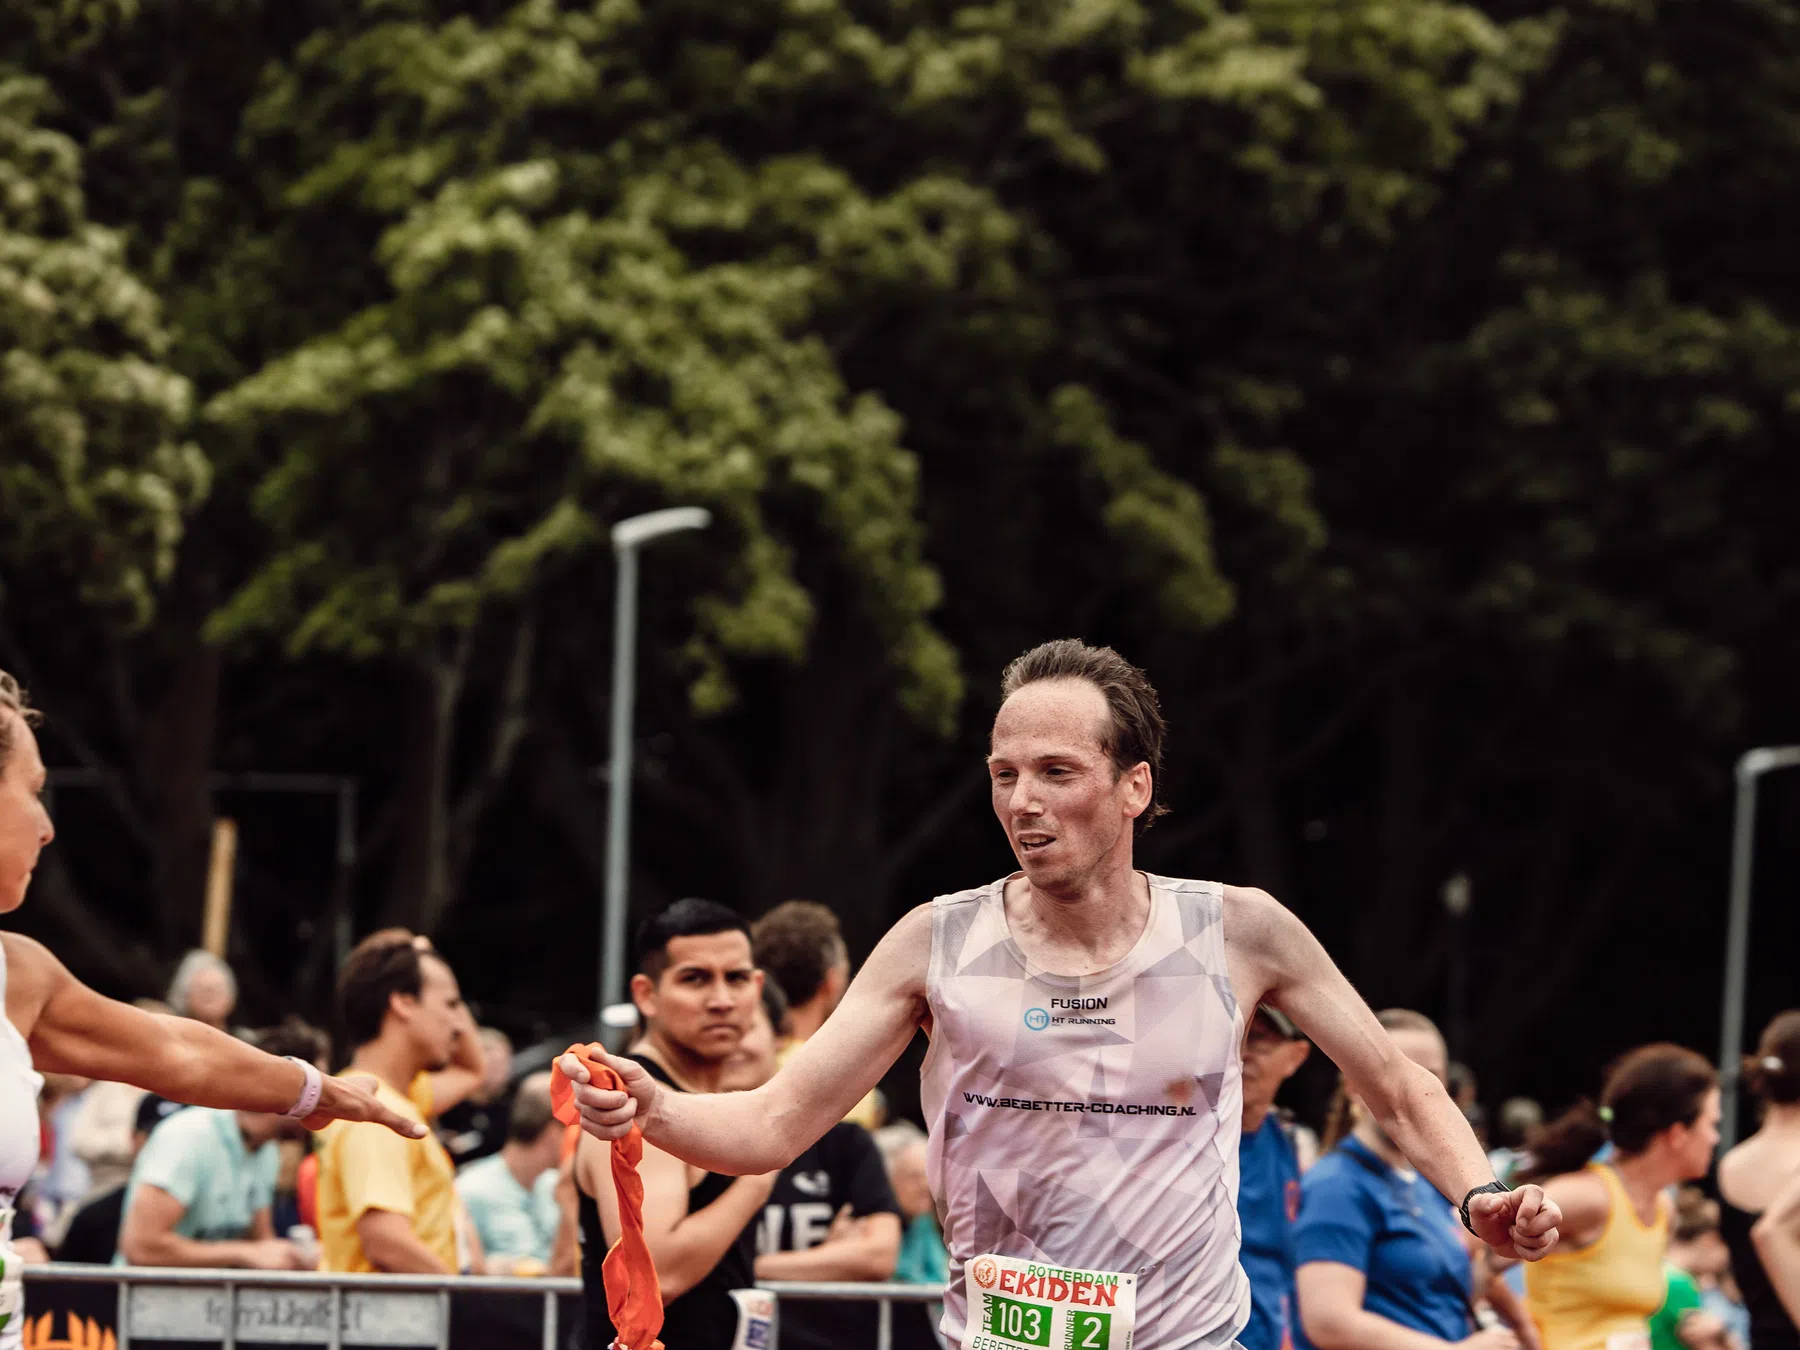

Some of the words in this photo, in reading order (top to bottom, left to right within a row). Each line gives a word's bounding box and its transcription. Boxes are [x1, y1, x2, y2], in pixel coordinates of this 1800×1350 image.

[1051, 997, 1108, 1010] FUSION
[1051, 1016, 1066, 1024] HT
[1067, 1017, 1116, 1025] RUNNING
[963, 1092, 1197, 1116] WWW.BEBETTER-COACHING.NL
[999, 1269, 1120, 1307] EKIDEN
[1028, 1264, 1118, 1285] ROTTERDAM
[982, 1292, 993, 1333] TEAM
[999, 1302, 1041, 1342] 103
[1064, 1309, 1075, 1350] RUNNER
[1081, 1316, 1102, 1348] 2
